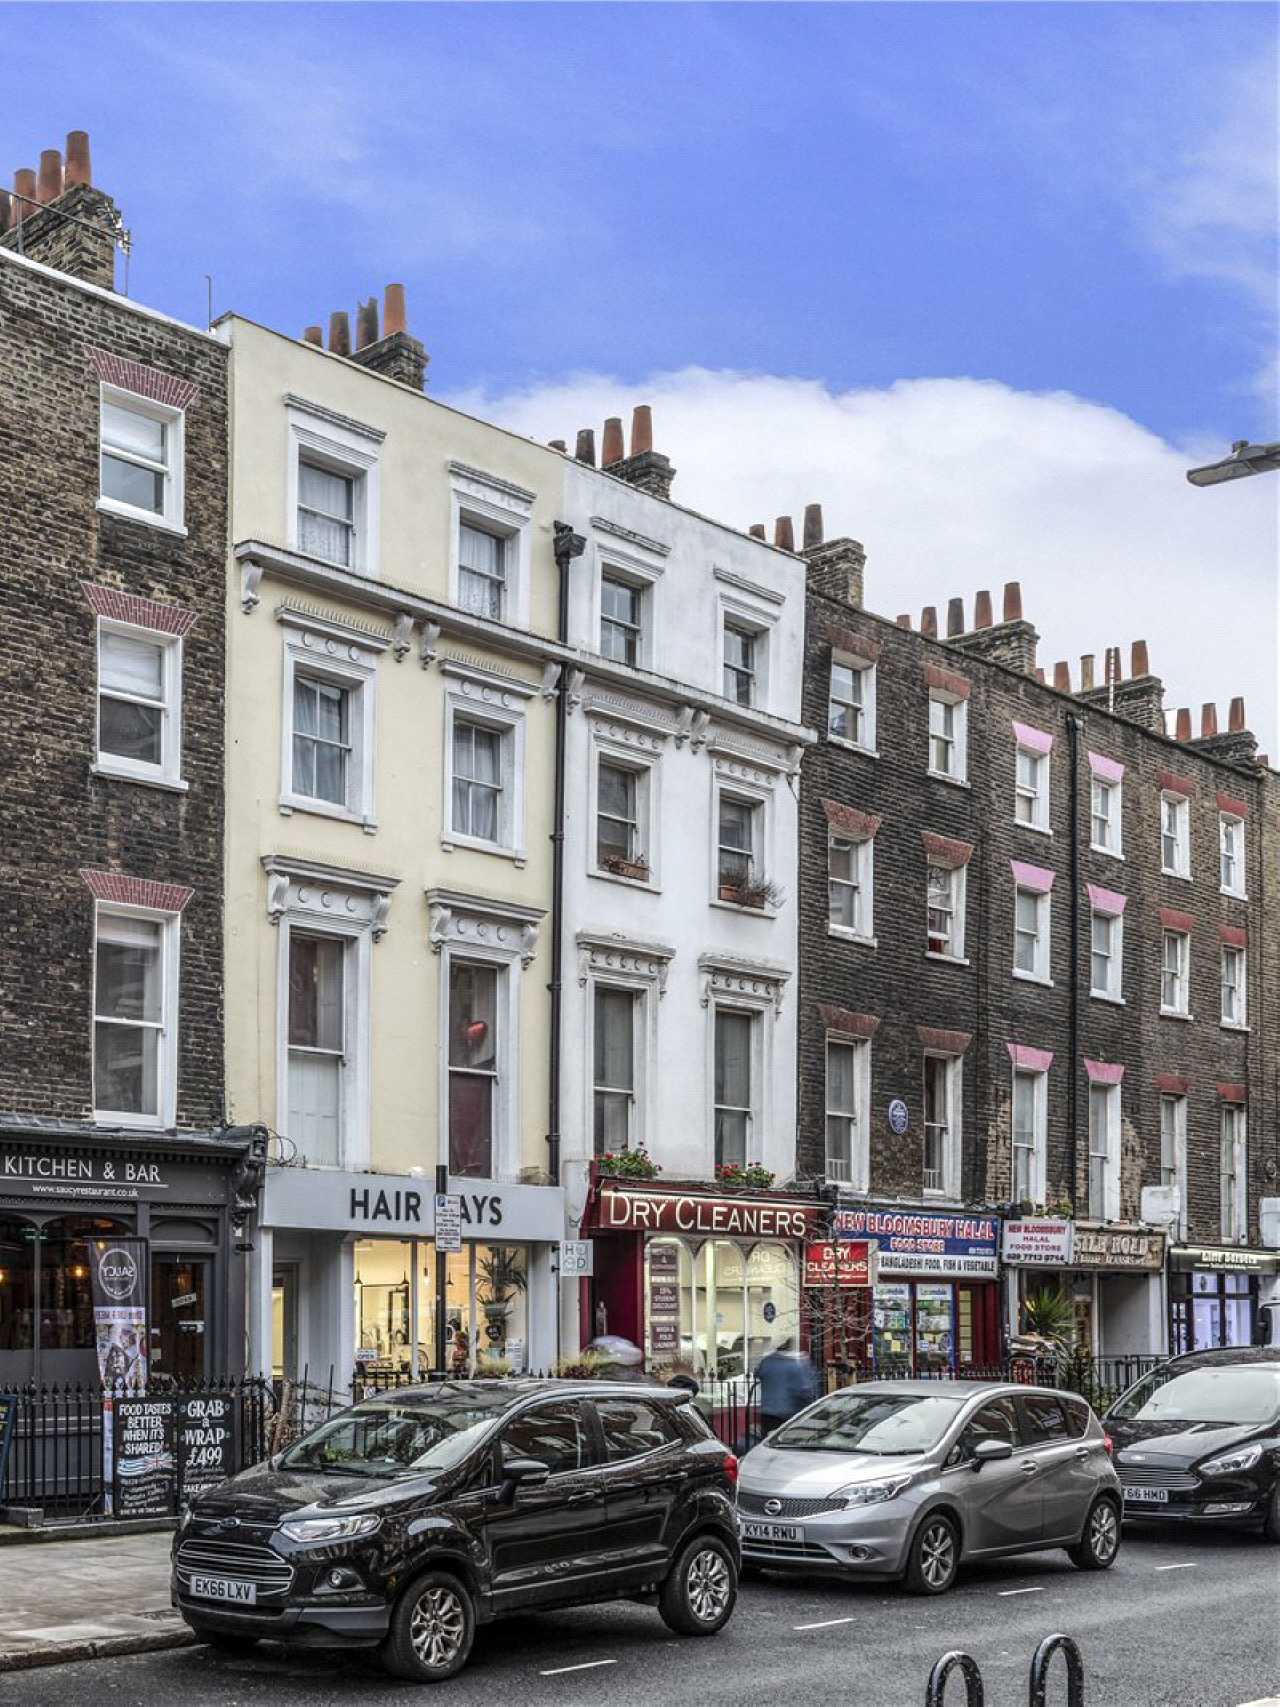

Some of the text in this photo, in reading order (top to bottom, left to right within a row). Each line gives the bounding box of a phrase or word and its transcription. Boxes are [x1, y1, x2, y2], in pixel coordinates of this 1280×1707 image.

[4, 1155, 161, 1182] KITCHEN & BAR
[350, 1188, 422, 1223] HAIR
[460, 1194, 503, 1226] AYS
[609, 1194, 806, 1238] DRY CLEANERS
[833, 1210, 995, 1241] NEW BLOOMSBURY HALAL
[1023, 1235, 1050, 1243] HALAL
[1035, 1244, 1062, 1252] STORE
[119, 1403, 172, 1416] FOOD TASTES
[187, 1400, 225, 1418] GRAB
[127, 1416, 164, 1429] BETTER
[123, 1429, 149, 1441] WHEN
[184, 1428, 226, 1446] WRAP
[746, 1523, 770, 1536] KY14
[195, 1580, 251, 1600] EK66 LXV
